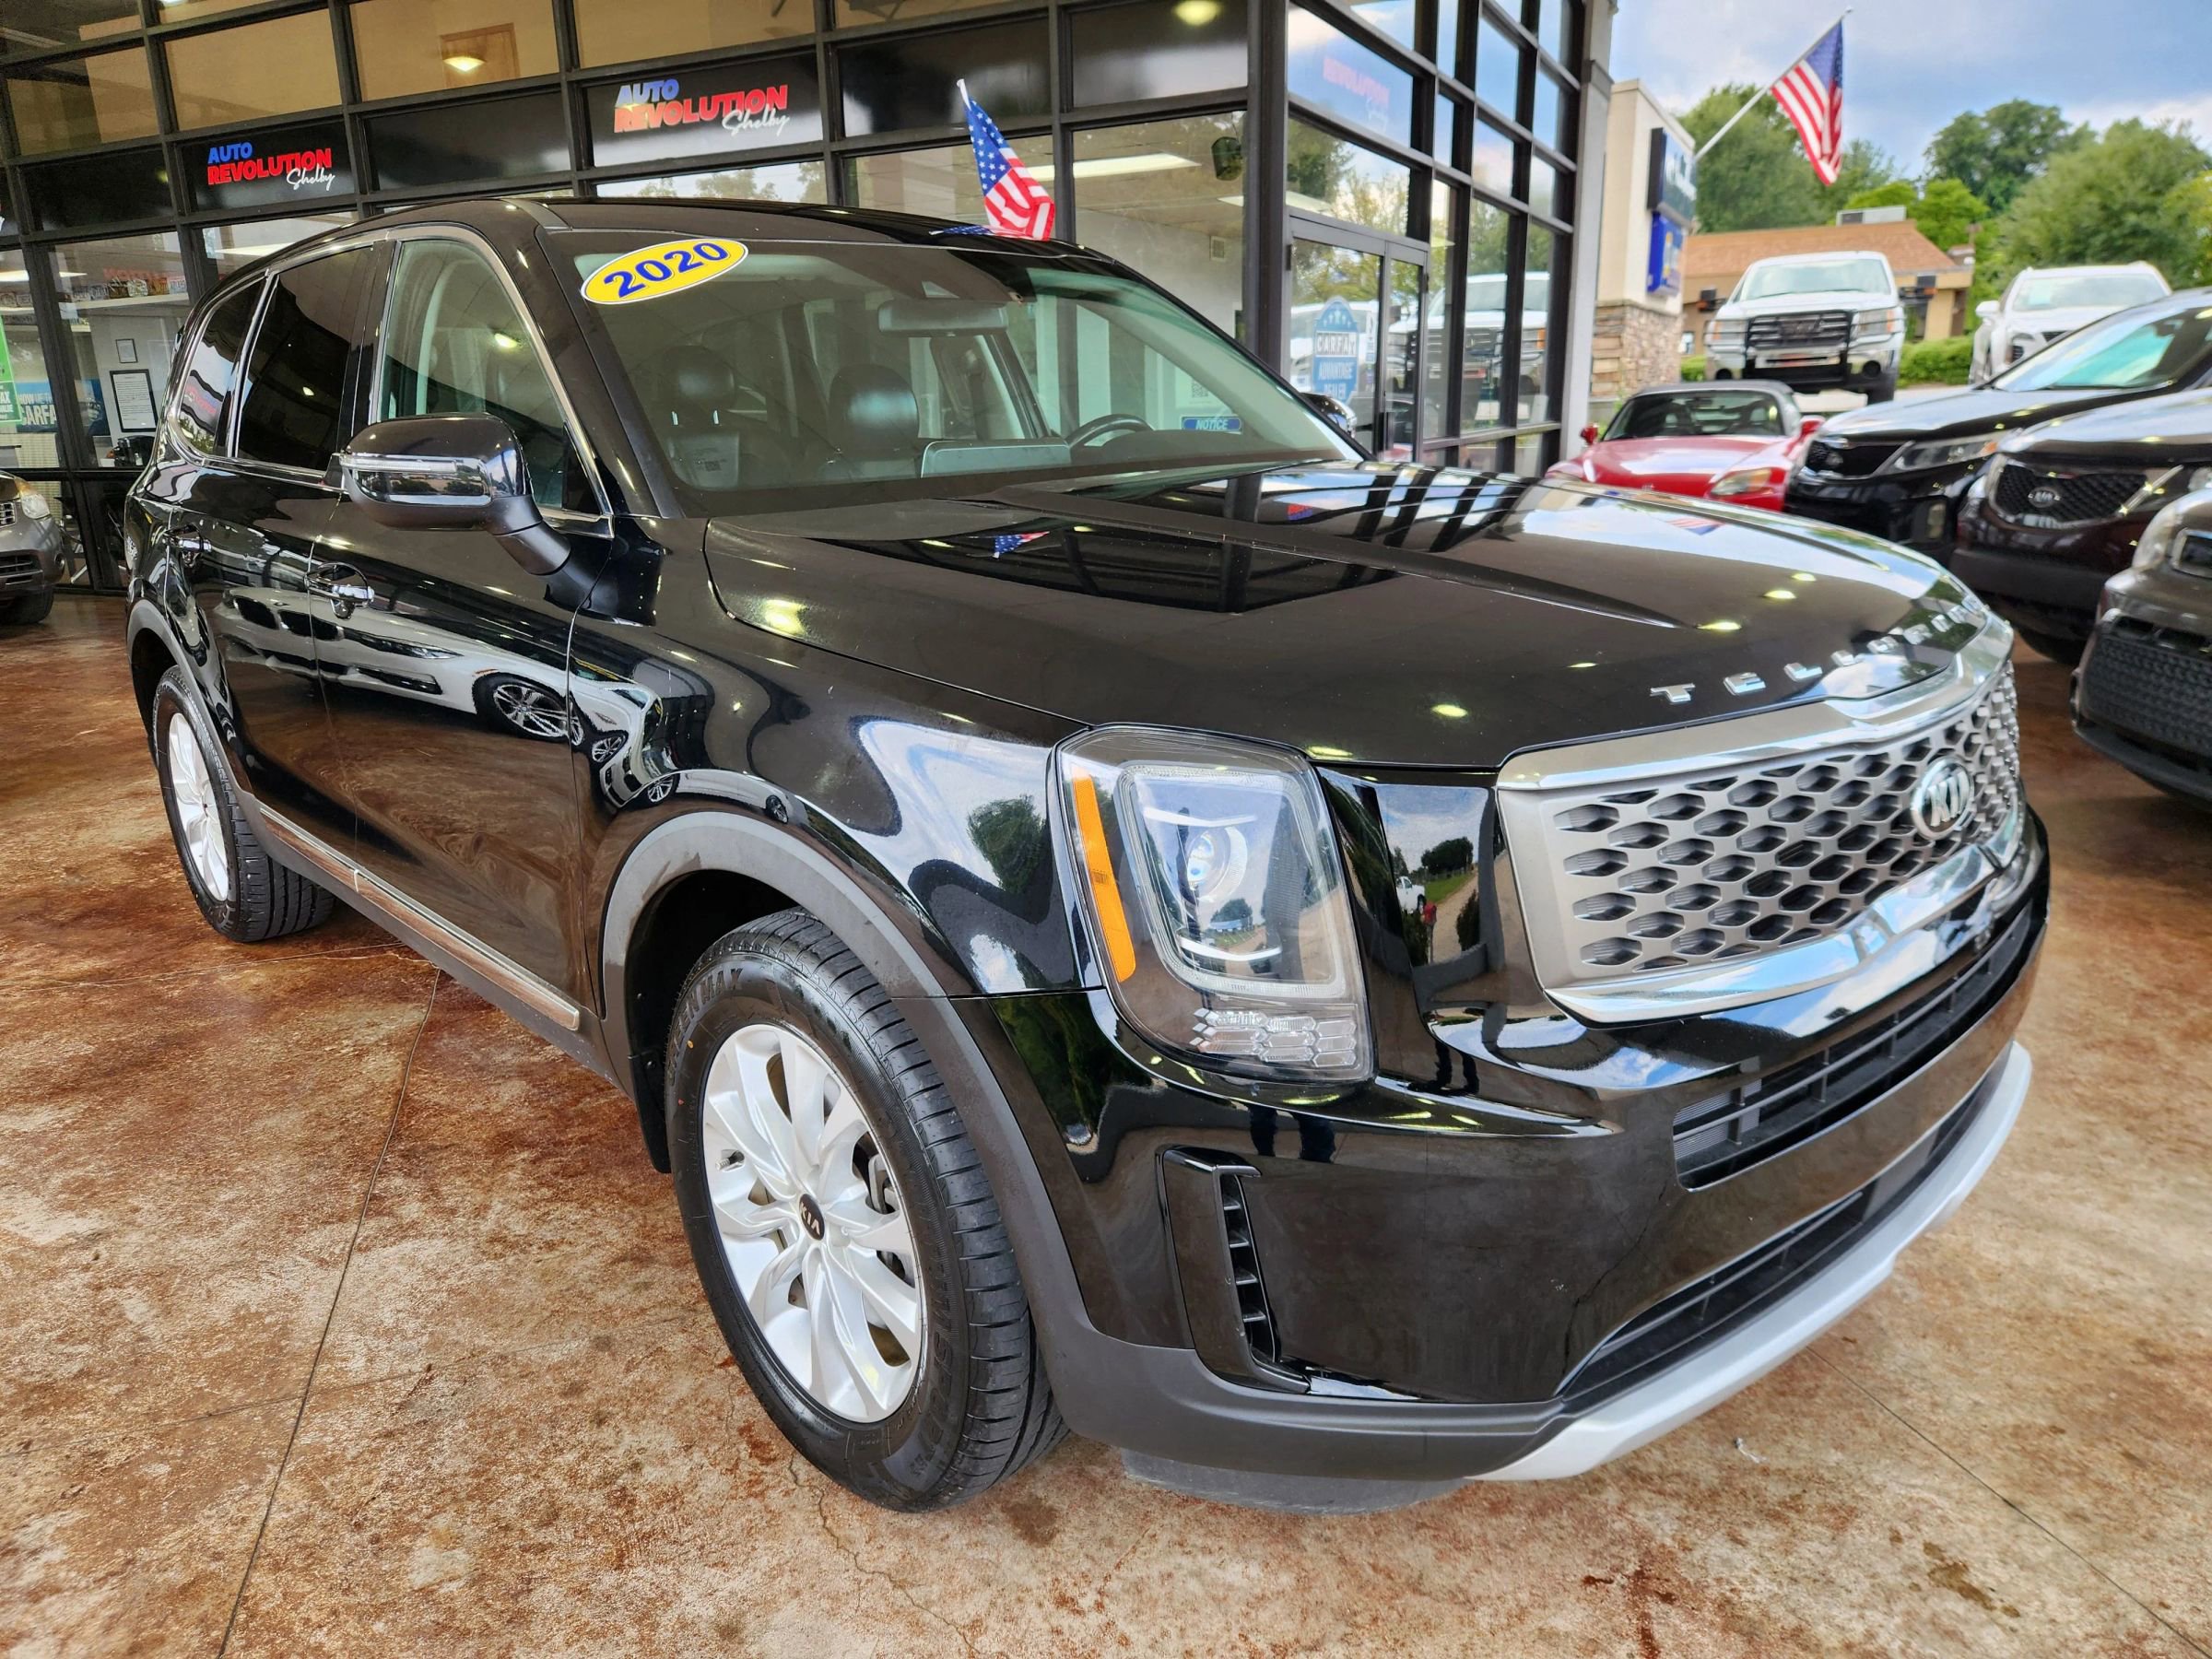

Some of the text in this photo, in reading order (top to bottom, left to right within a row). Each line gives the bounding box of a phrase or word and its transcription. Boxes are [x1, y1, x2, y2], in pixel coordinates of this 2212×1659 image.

[614, 84, 788, 133] REVOLUTION
[615, 78, 679, 108] AUTO
[722, 103, 790, 136] Shelby
[207, 141, 253, 164] AUTO
[207, 147, 333, 185] REVOLUTION
[287, 163, 335, 191] Shelby
[603, 242, 729, 298] 2020
[1316, 333, 1356, 355] CARFAX
[19, 404, 57, 426] CARFA
[1195, 419, 1229, 430] NOTICE
[1926, 766, 1970, 827] KIA
[800, 1201, 820, 1235] KIA
